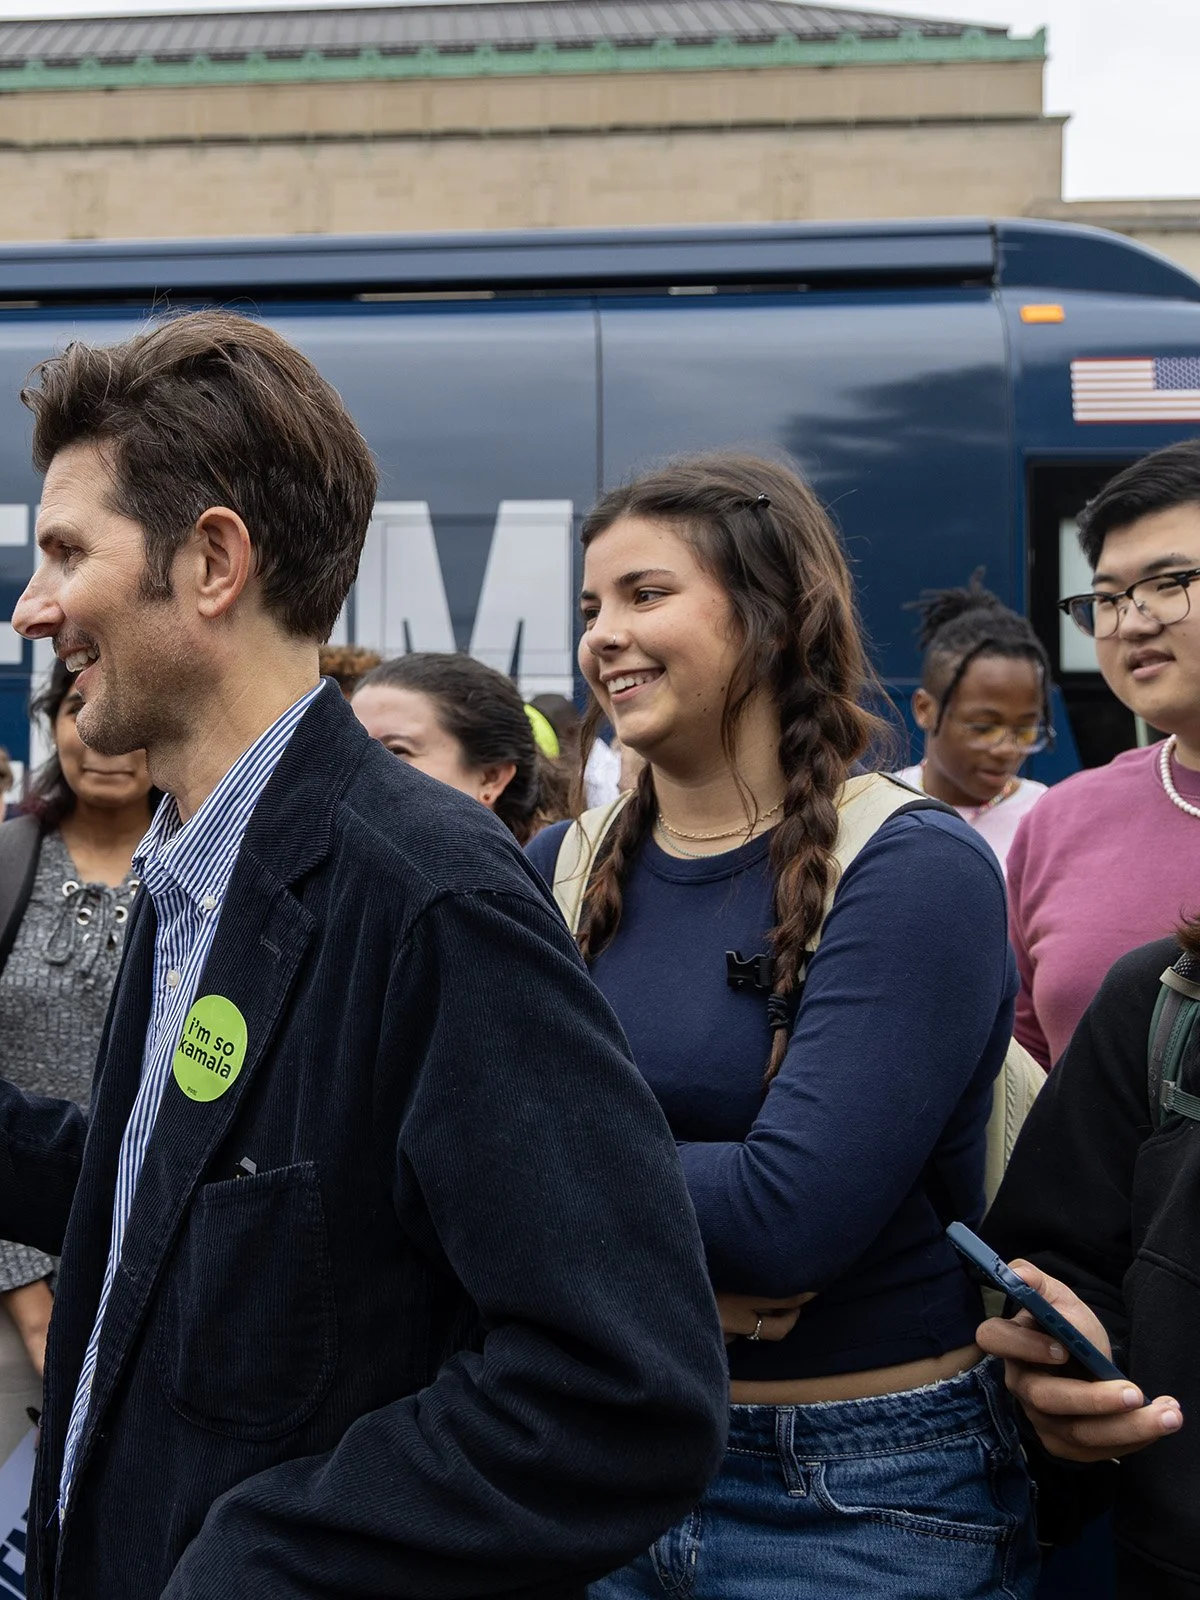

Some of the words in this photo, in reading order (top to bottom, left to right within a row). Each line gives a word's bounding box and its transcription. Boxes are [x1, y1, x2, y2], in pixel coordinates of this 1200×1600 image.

[178, 1034, 232, 1079] kamala
[188, 1016, 211, 1044] i'm
[213, 1036, 235, 1056] so
